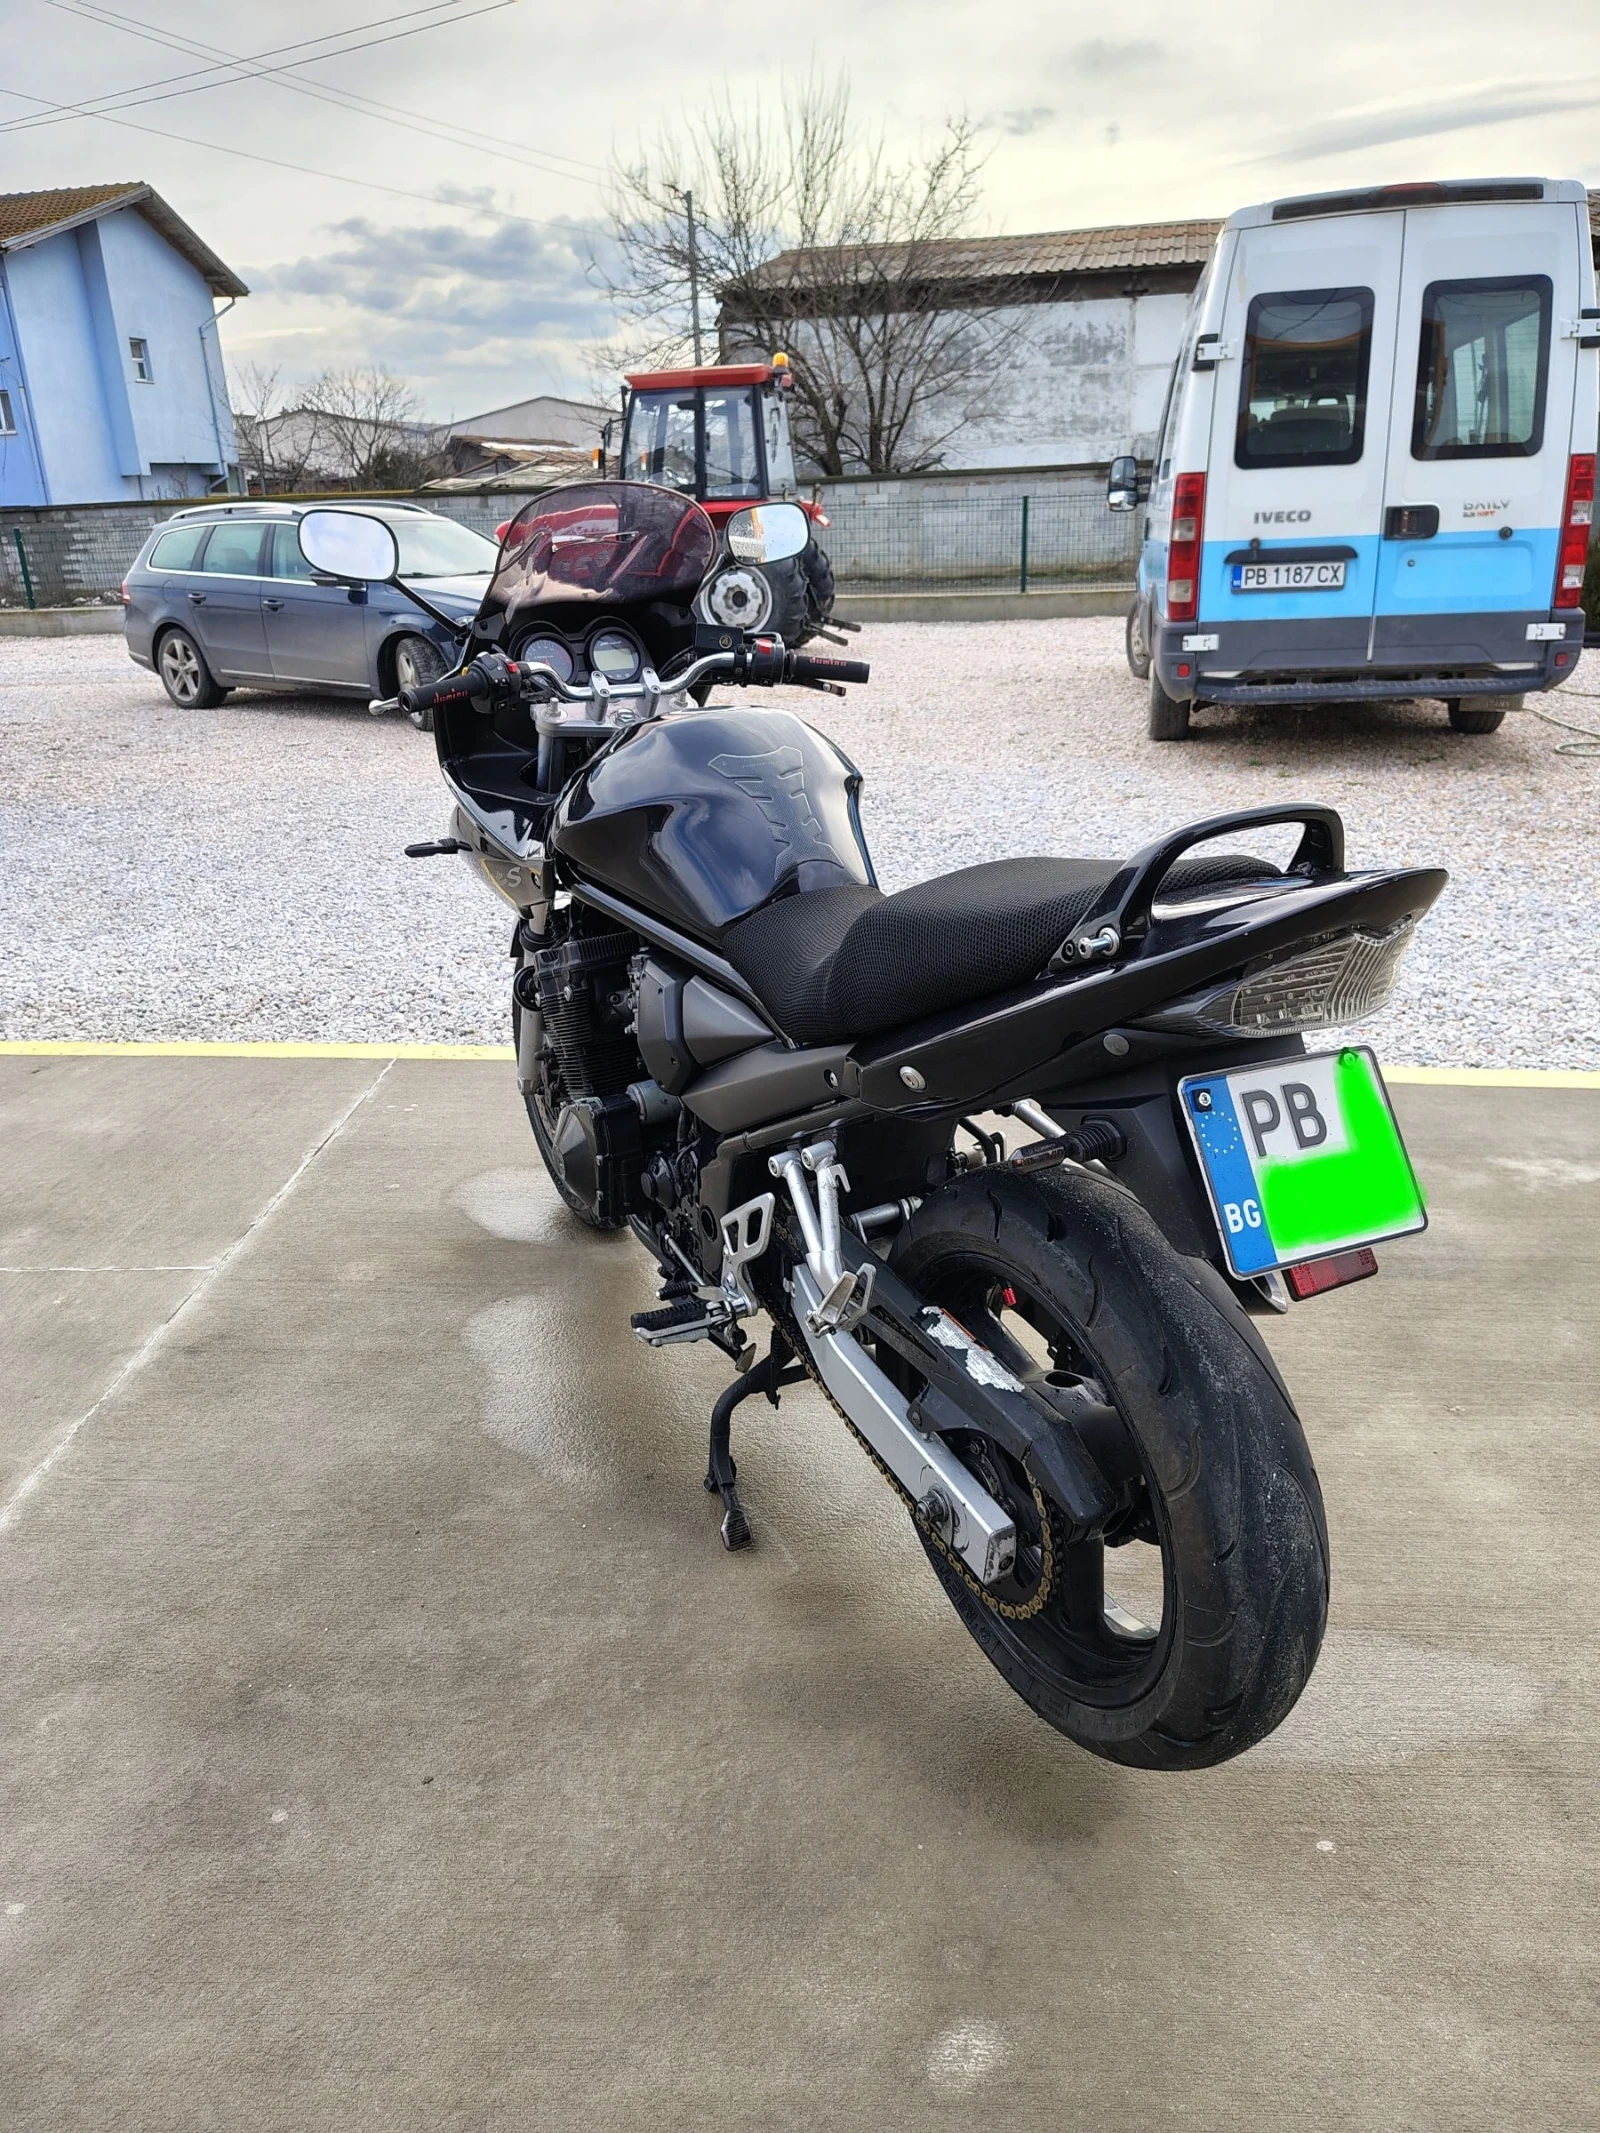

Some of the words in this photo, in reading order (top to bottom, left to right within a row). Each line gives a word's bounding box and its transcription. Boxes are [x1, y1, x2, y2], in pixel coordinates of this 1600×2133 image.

[1253, 509, 1312, 525] IVECO
[1244, 567, 1267, 586] PB
[1273, 565, 1315, 585] 1187
[1317, 565, 1343, 584] CX
[1239, 1082, 1328, 1158] PB
[1223, 1198, 1262, 1234] BG
